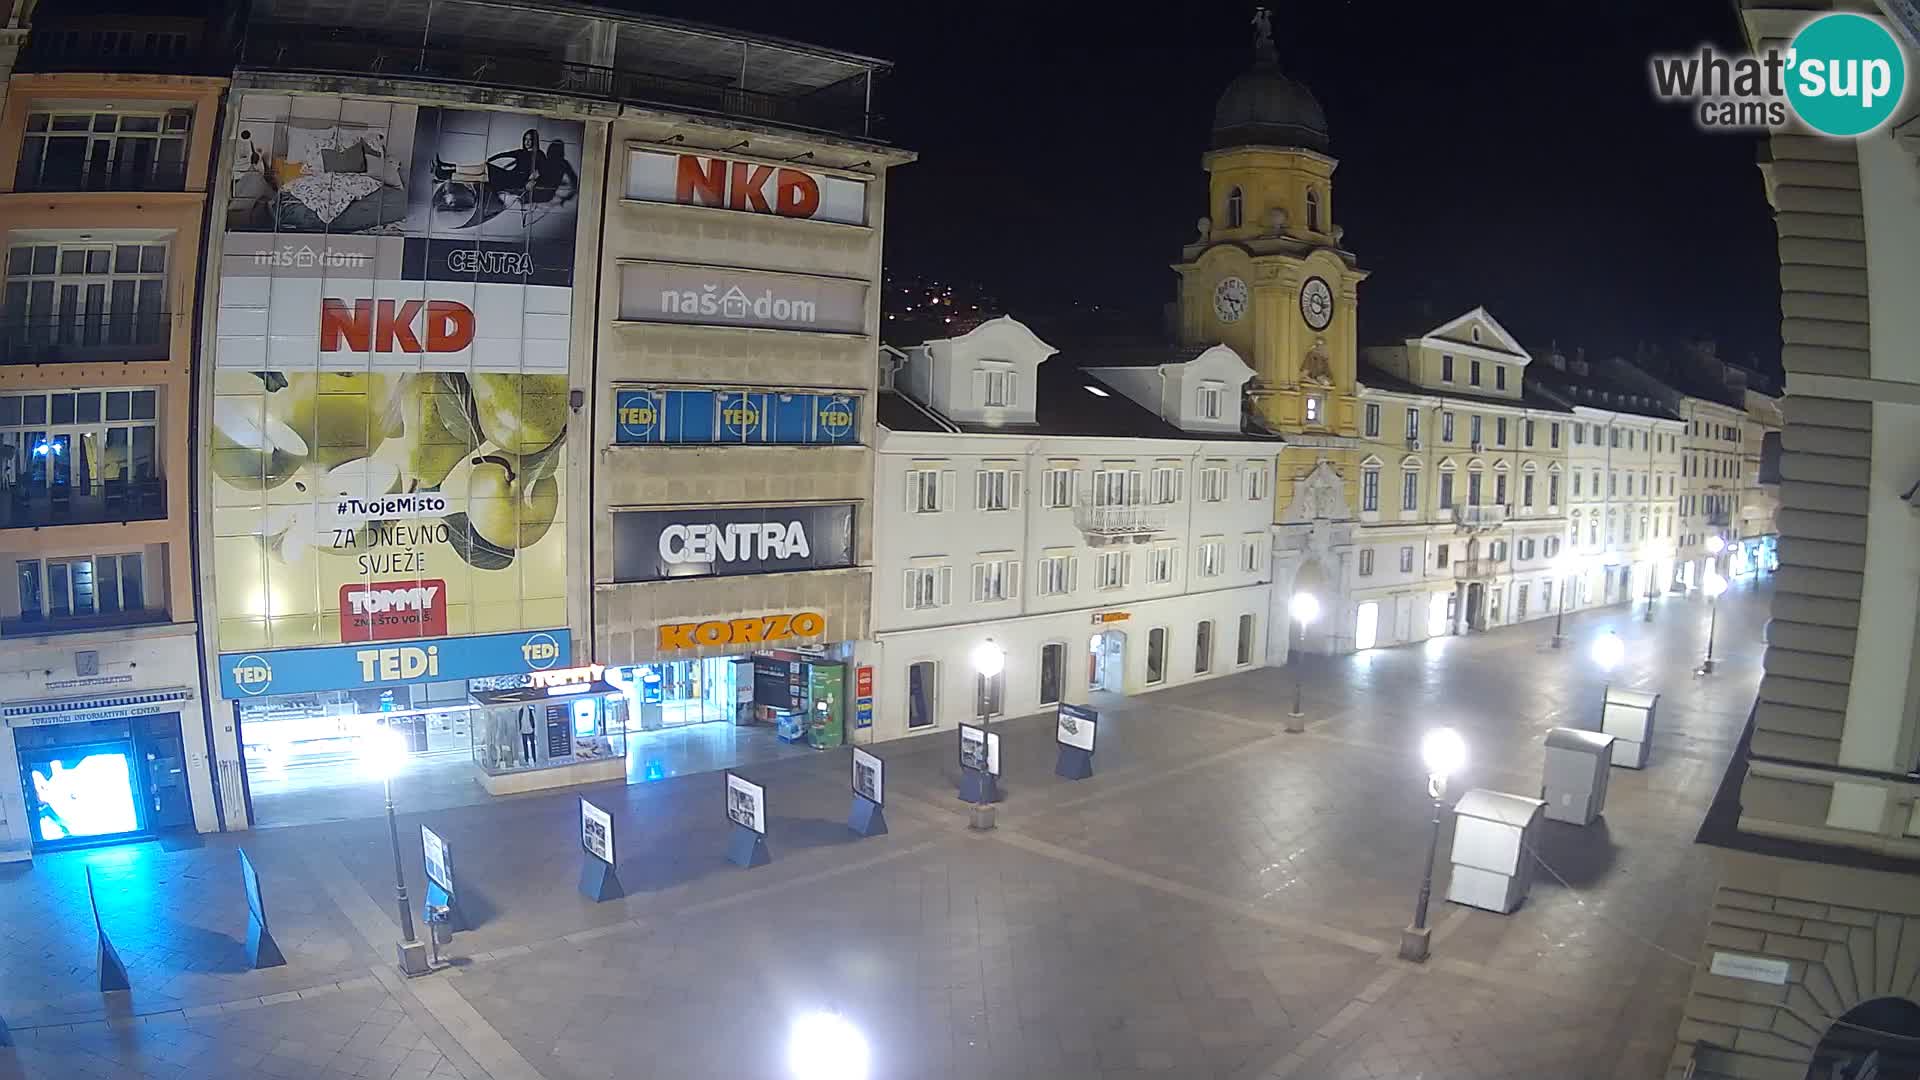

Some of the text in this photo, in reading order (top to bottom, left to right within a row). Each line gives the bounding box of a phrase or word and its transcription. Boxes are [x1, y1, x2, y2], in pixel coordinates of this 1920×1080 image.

[675, 153, 821, 219] NKD
[254, 247, 365, 269] naš dom
[447, 249, 535, 276] CENTRA
[660, 283, 817, 323] naš dom
[319, 297, 477, 353] NKD
[618, 408, 658, 425] TEDi
[723, 408, 760, 426] TEDi
[819, 411, 853, 427] TEDi
[337, 496, 446, 517] #TvojeMisto
[332, 523, 450, 549] ZA DNEVNO
[658, 520, 811, 565] CENTRA
[358, 547, 426, 575] SVJEŽE
[347, 585, 439, 615] TOMMY
[658, 611, 825, 652] KORZO
[356, 645, 440, 683] TEDi
[521, 641, 560, 662] TEDi
[232, 665, 272, 685] TEDi
[130, 706, 161, 716] CENTAR
